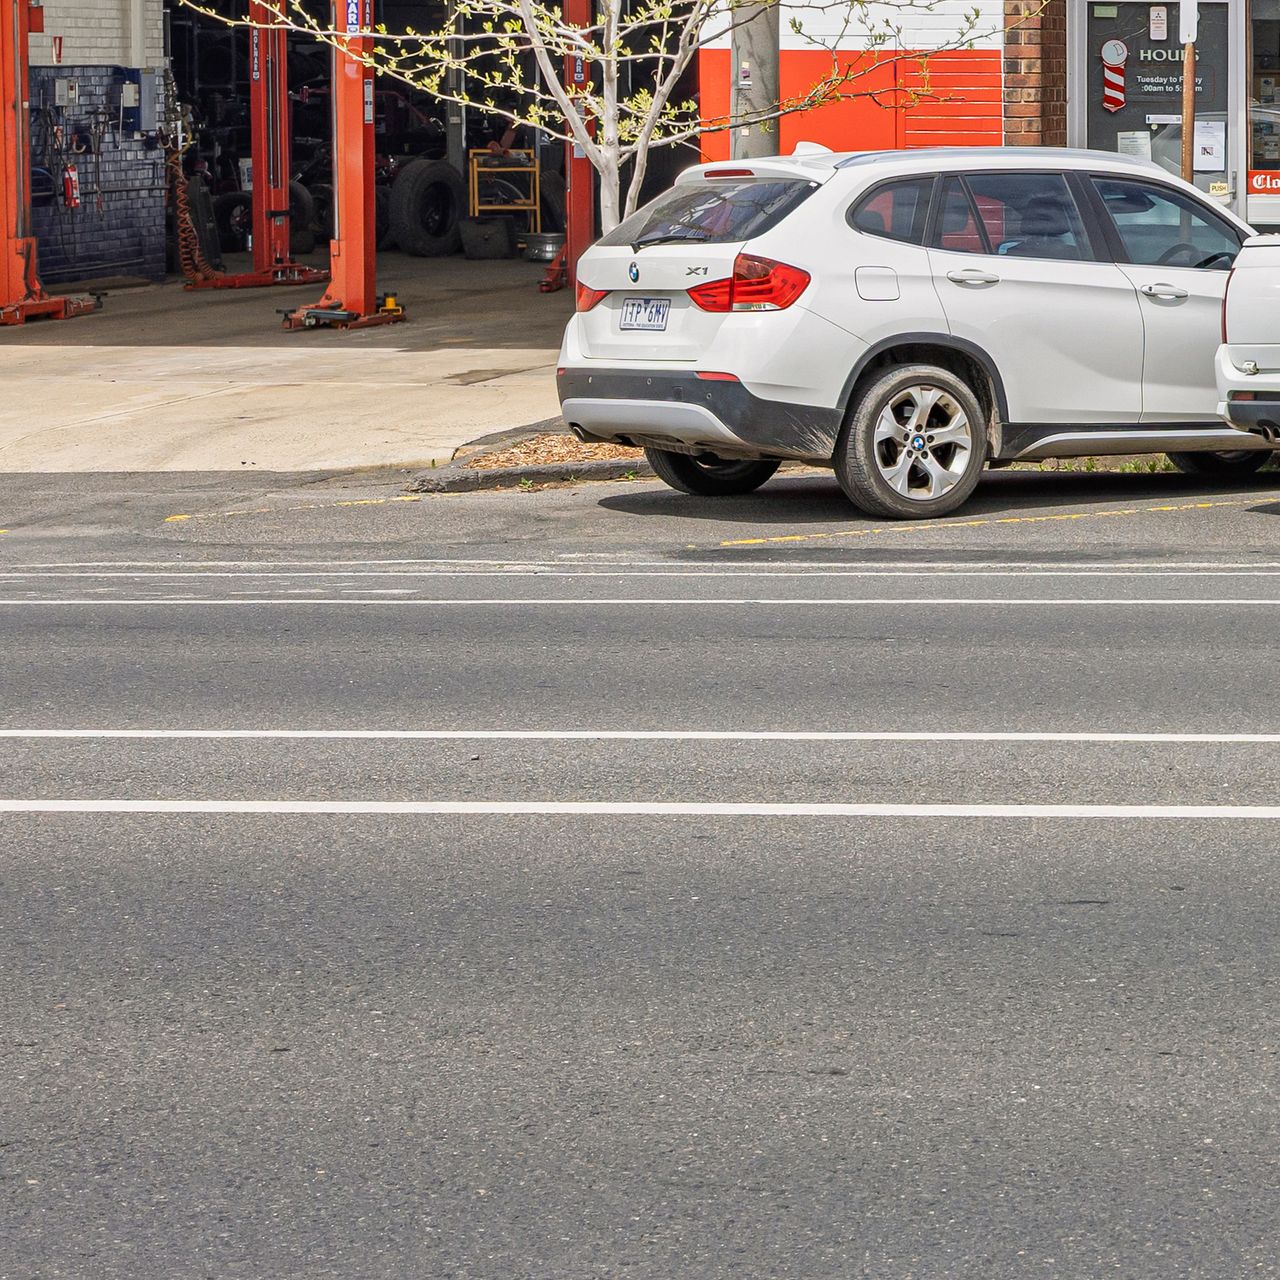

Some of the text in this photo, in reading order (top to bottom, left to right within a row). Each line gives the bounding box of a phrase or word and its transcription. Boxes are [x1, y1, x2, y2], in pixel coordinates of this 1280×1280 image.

[1136, 75, 1169, 85] Tuesday
[1169, 75, 1178, 83] to
[685, 266, 709, 276] X1
